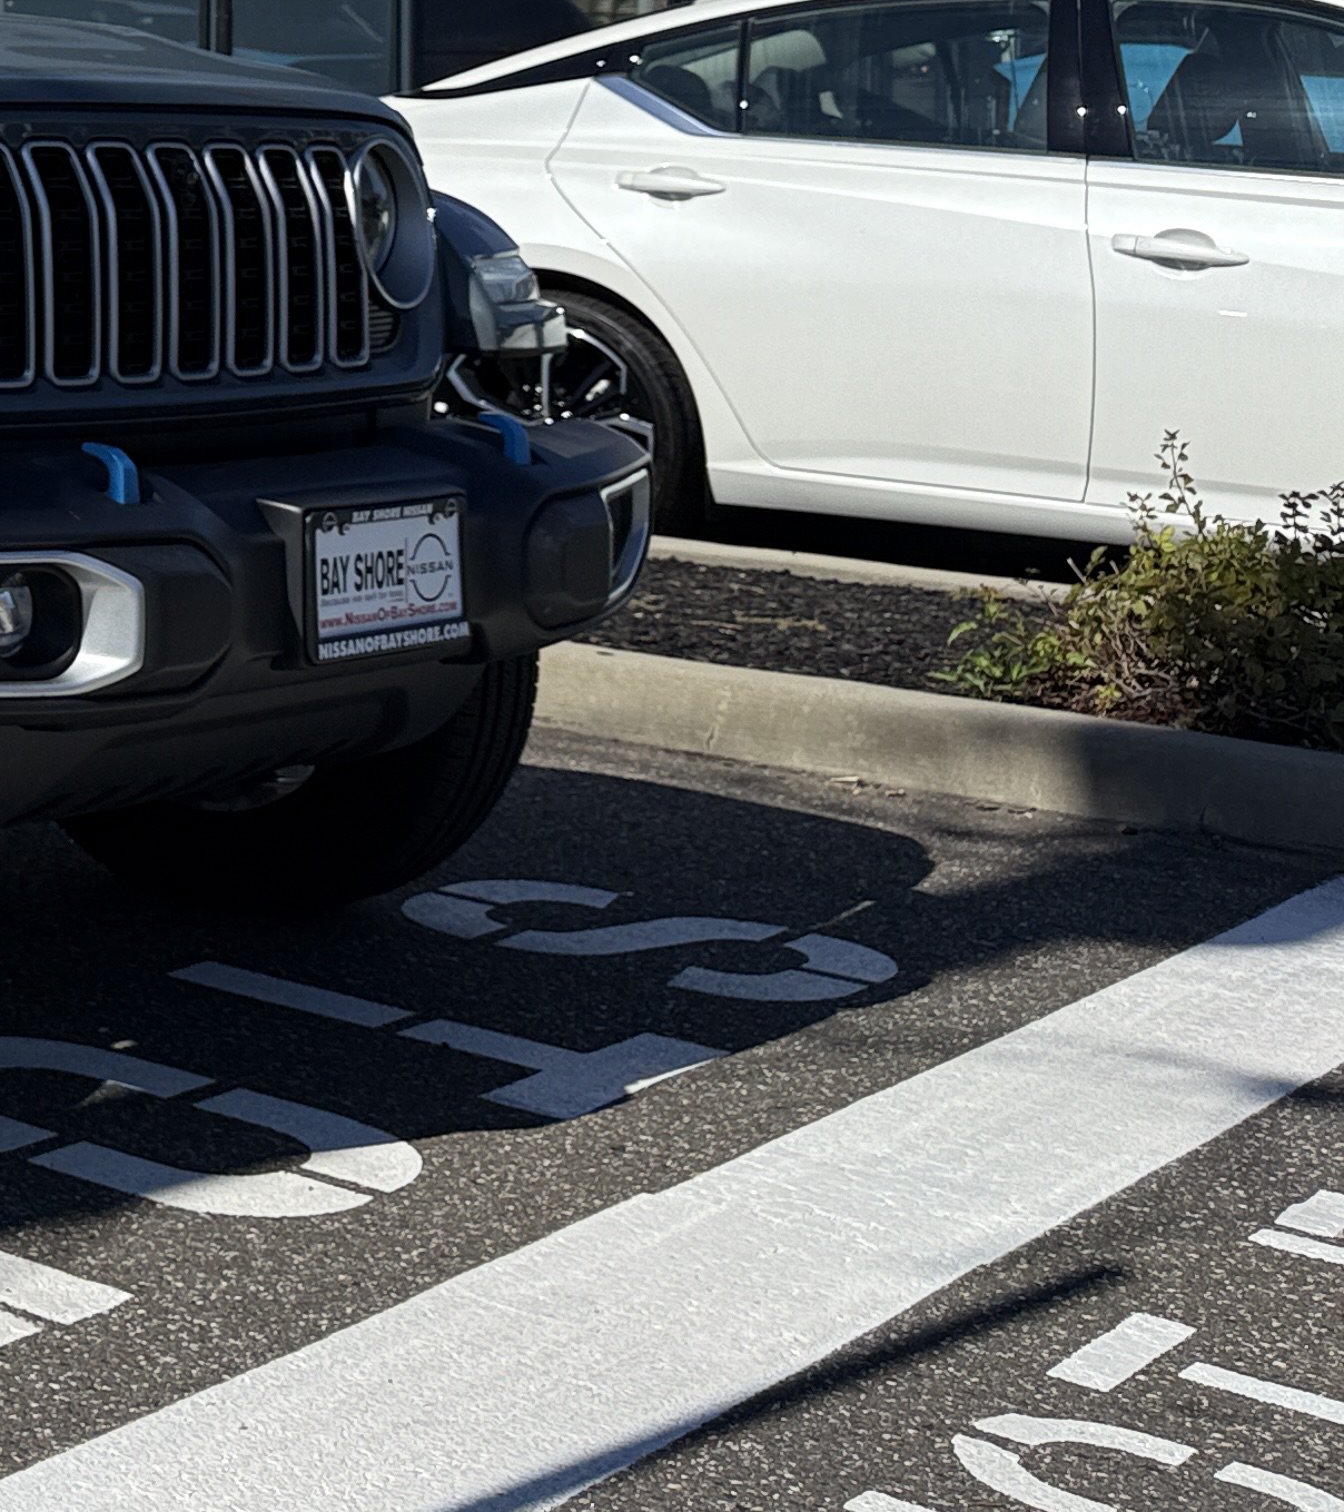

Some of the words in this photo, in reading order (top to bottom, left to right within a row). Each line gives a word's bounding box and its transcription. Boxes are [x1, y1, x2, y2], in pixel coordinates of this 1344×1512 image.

[351, 509, 369, 523] BAY
[372, 506, 401, 521] SHORE
[402, 502, 434, 517] NISSAN
[320, 556, 350, 597] BAY
[354, 549, 405, 592] SHORE
[406, 560, 454, 577] NISSAN
[318, 621, 470, 661] NISSANOFBAYSHORE.COM
